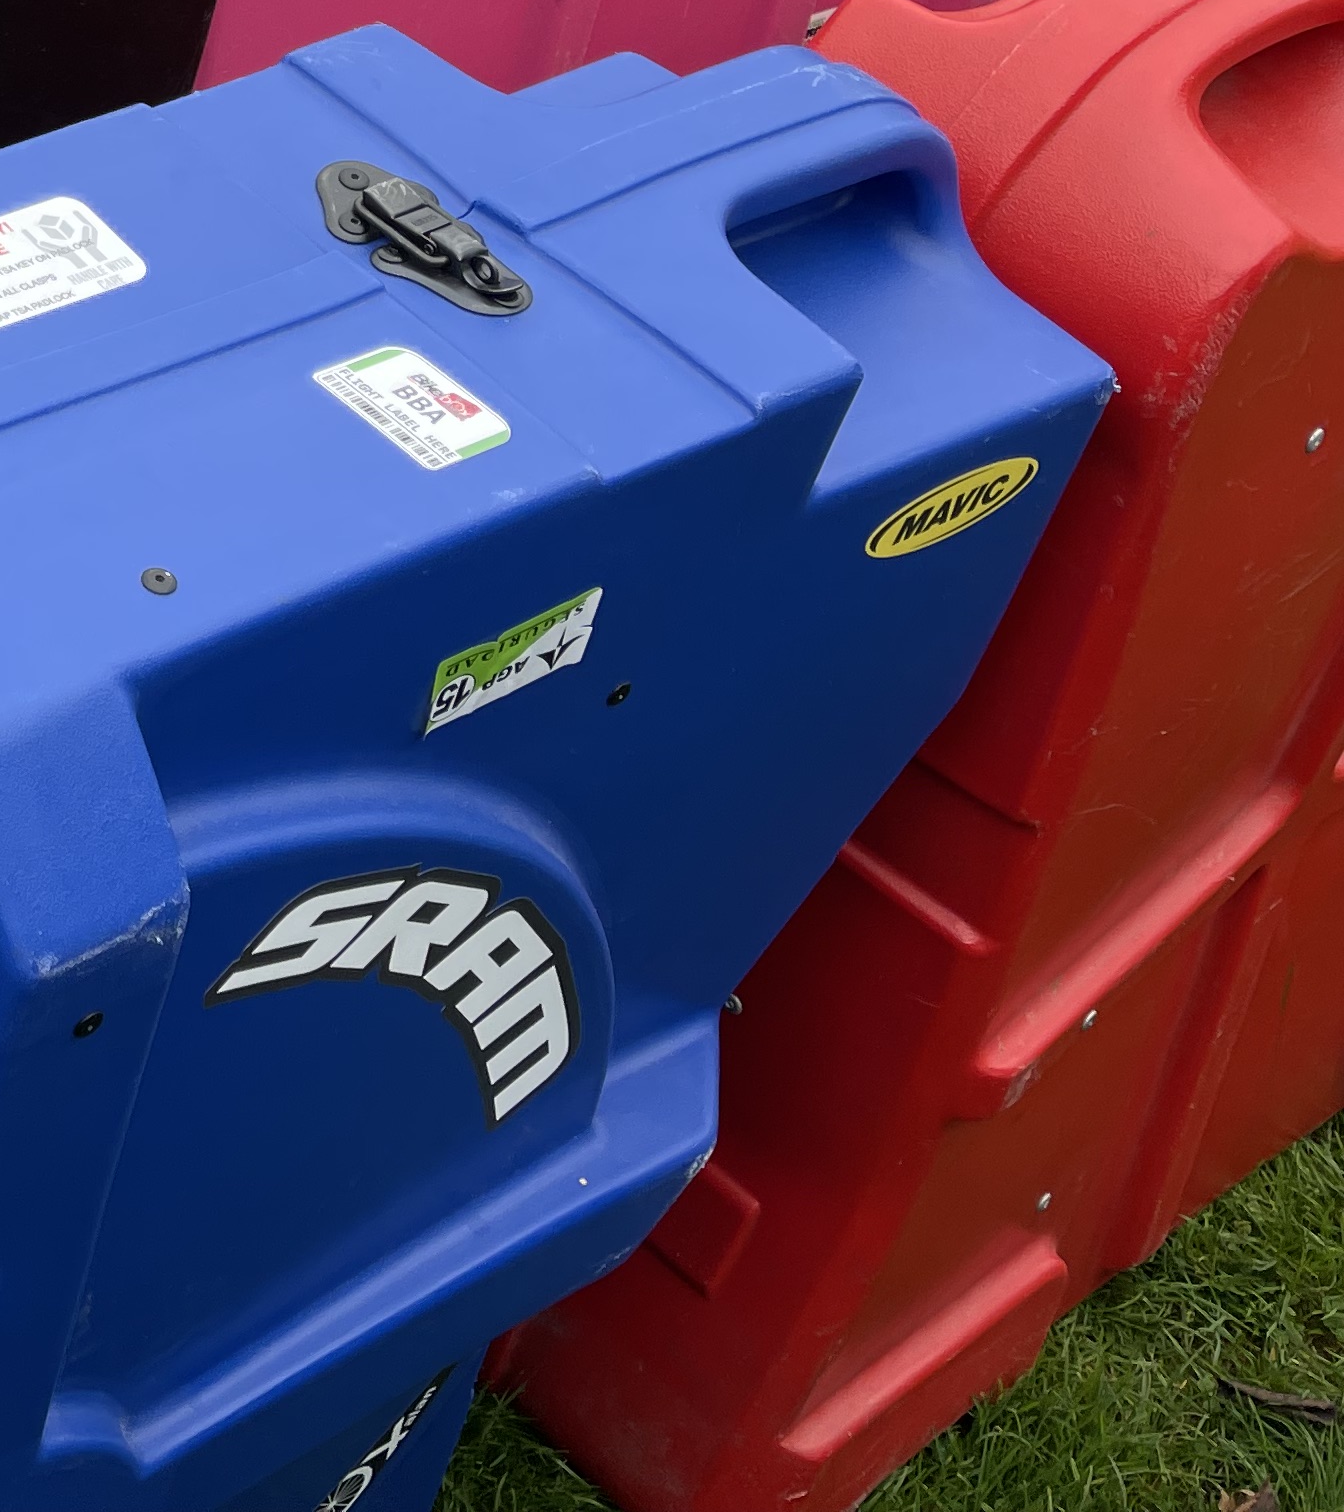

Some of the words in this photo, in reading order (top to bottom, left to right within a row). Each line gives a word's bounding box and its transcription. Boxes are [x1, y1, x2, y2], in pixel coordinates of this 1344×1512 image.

[12, 257, 37, 270] KEY
[32, 252, 53, 263] ON
[47, 237, 97, 258] PADLOCK
[66, 265, 110, 285] HANDLE
[102, 255, 136, 272] WITH
[16, 272, 59, 291] CLASPS
[95, 273, 129, 290] CARE
[9, 303, 35, 317] TSA
[28, 289, 77, 310] PADLOCK
[339, 369, 385, 400] FLIGHT
[385, 403, 421, 433] LABEL
[424, 435, 458, 460] HERE
[392, 385, 446, 424] BBA
[892, 474, 1010, 546] MAVIC
[482, 655, 530, 691] AGP
[432, 677, 471, 719] 15
[216, 879, 569, 1121] SRAM
